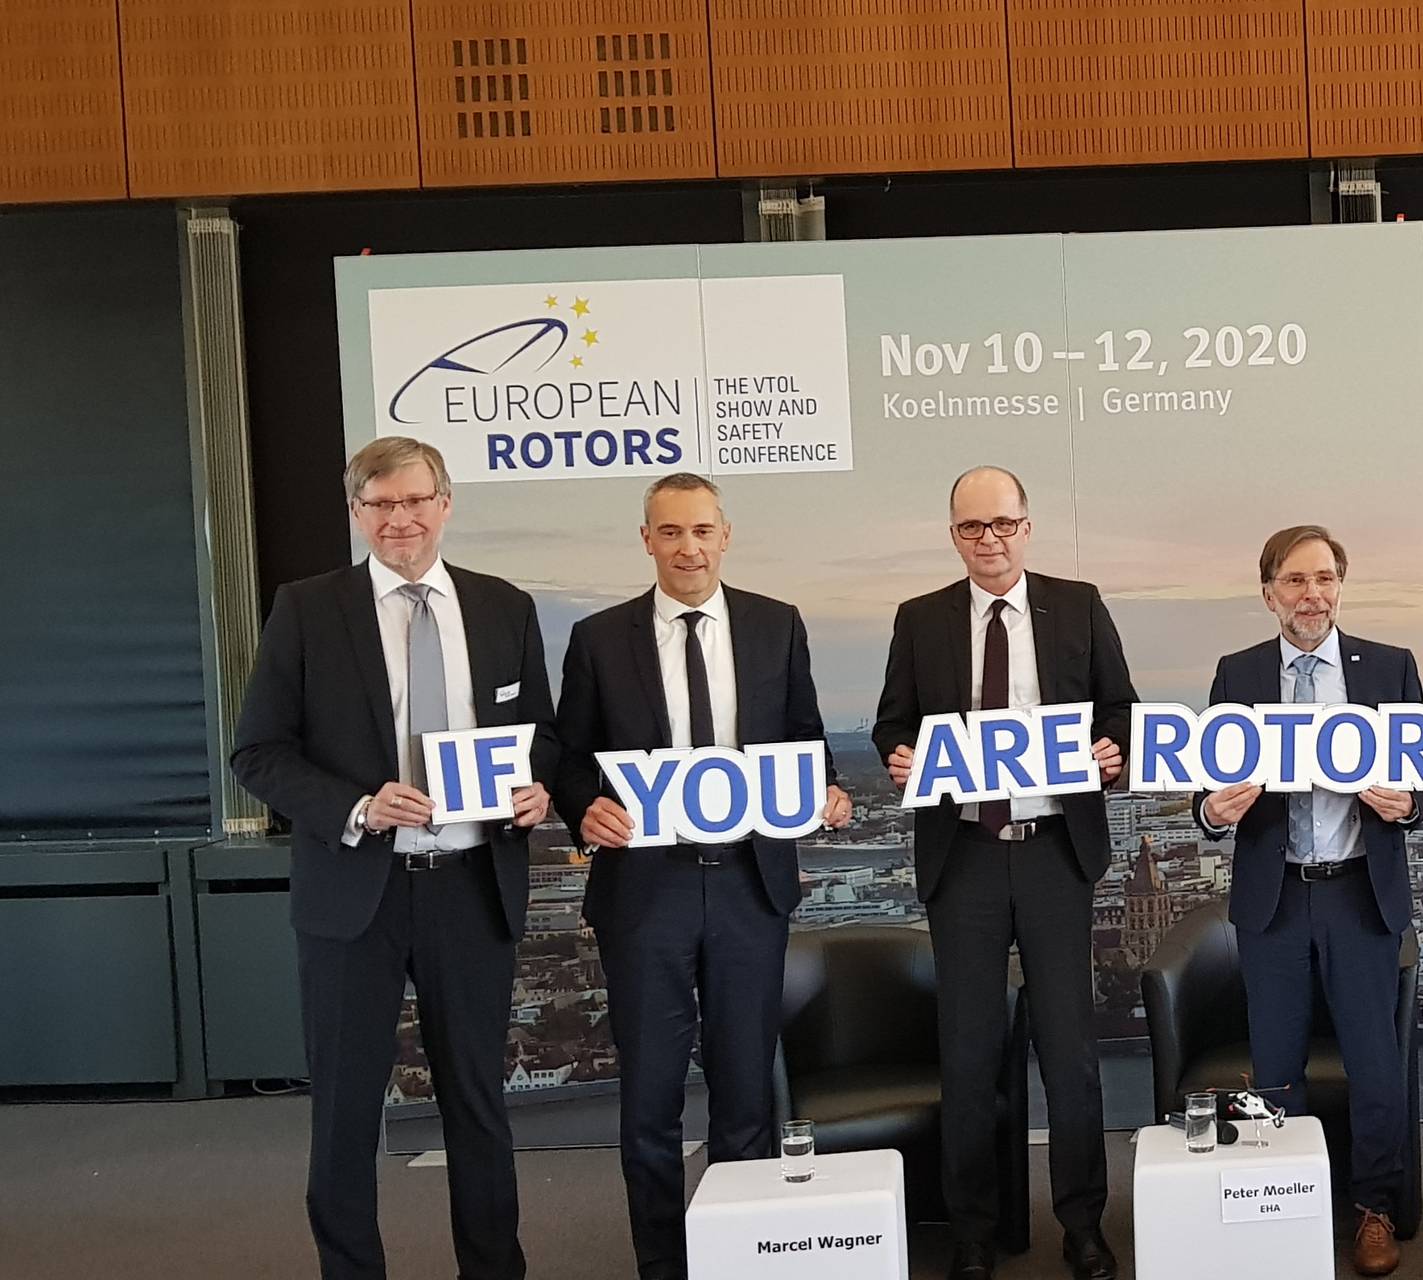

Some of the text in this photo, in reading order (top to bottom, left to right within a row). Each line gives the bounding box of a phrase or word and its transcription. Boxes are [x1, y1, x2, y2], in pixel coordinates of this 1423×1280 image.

[880, 333, 969, 376] Nov
[1183, 323, 1308, 368] 2020
[713, 375, 800, 396] THE VTOL
[446, 380, 680, 422] EUROPEAN
[717, 398, 817, 418] SHOW AND
[884, 391, 1058, 419] Koelnmesse
[1104, 388, 1232, 416] Germany
[718, 423, 783, 441] SAFETY
[488, 428, 682, 470] ROTORS
[719, 444, 837, 464] CONFERENCE
[917, 712, 1089, 797] ARE
[438, 736, 517, 812] IF
[616, 752, 816, 837] YOU
[1223, 1182, 1315, 1200] Peter Moeller
[1259, 1203, 1281, 1214] EHA
[757, 1234, 883, 1255] Marcel Wagner
